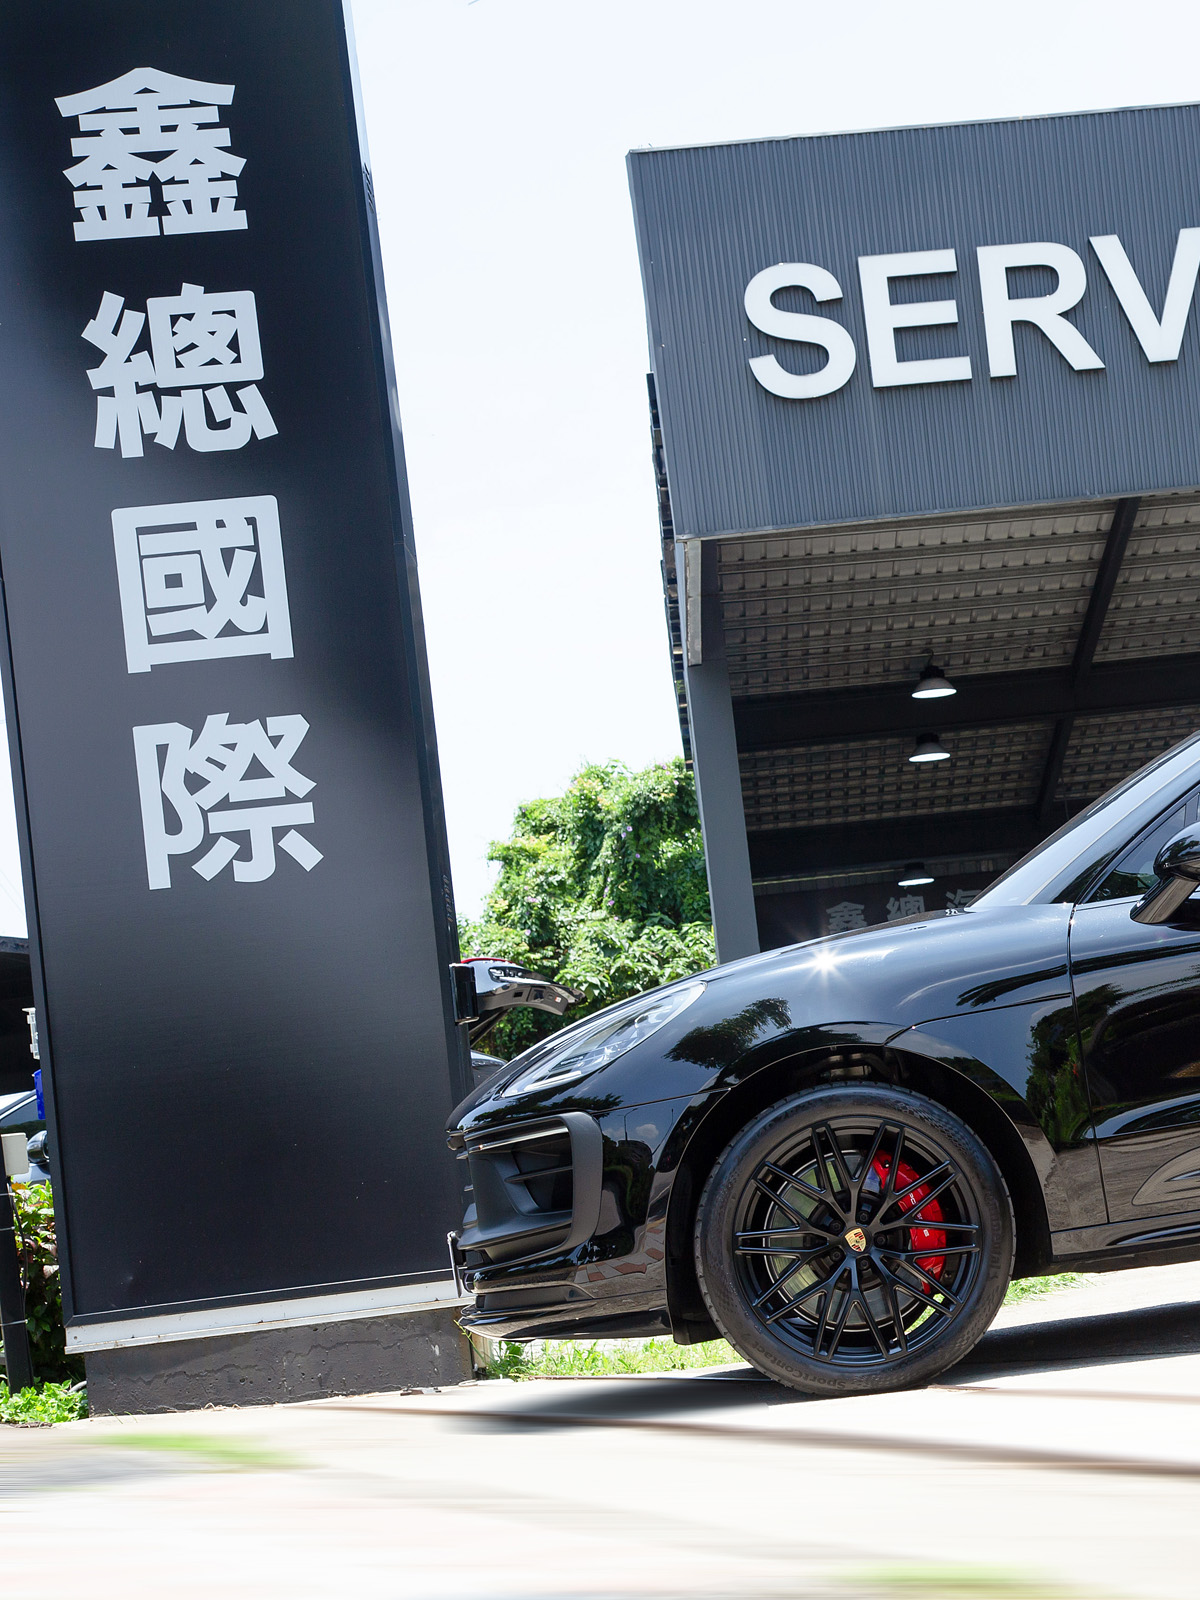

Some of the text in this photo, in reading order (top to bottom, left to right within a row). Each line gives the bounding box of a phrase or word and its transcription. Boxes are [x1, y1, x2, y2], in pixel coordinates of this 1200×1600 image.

[55, 67, 324, 890] 鑫總國際
[750, 1339, 846, 1390] SportContact
